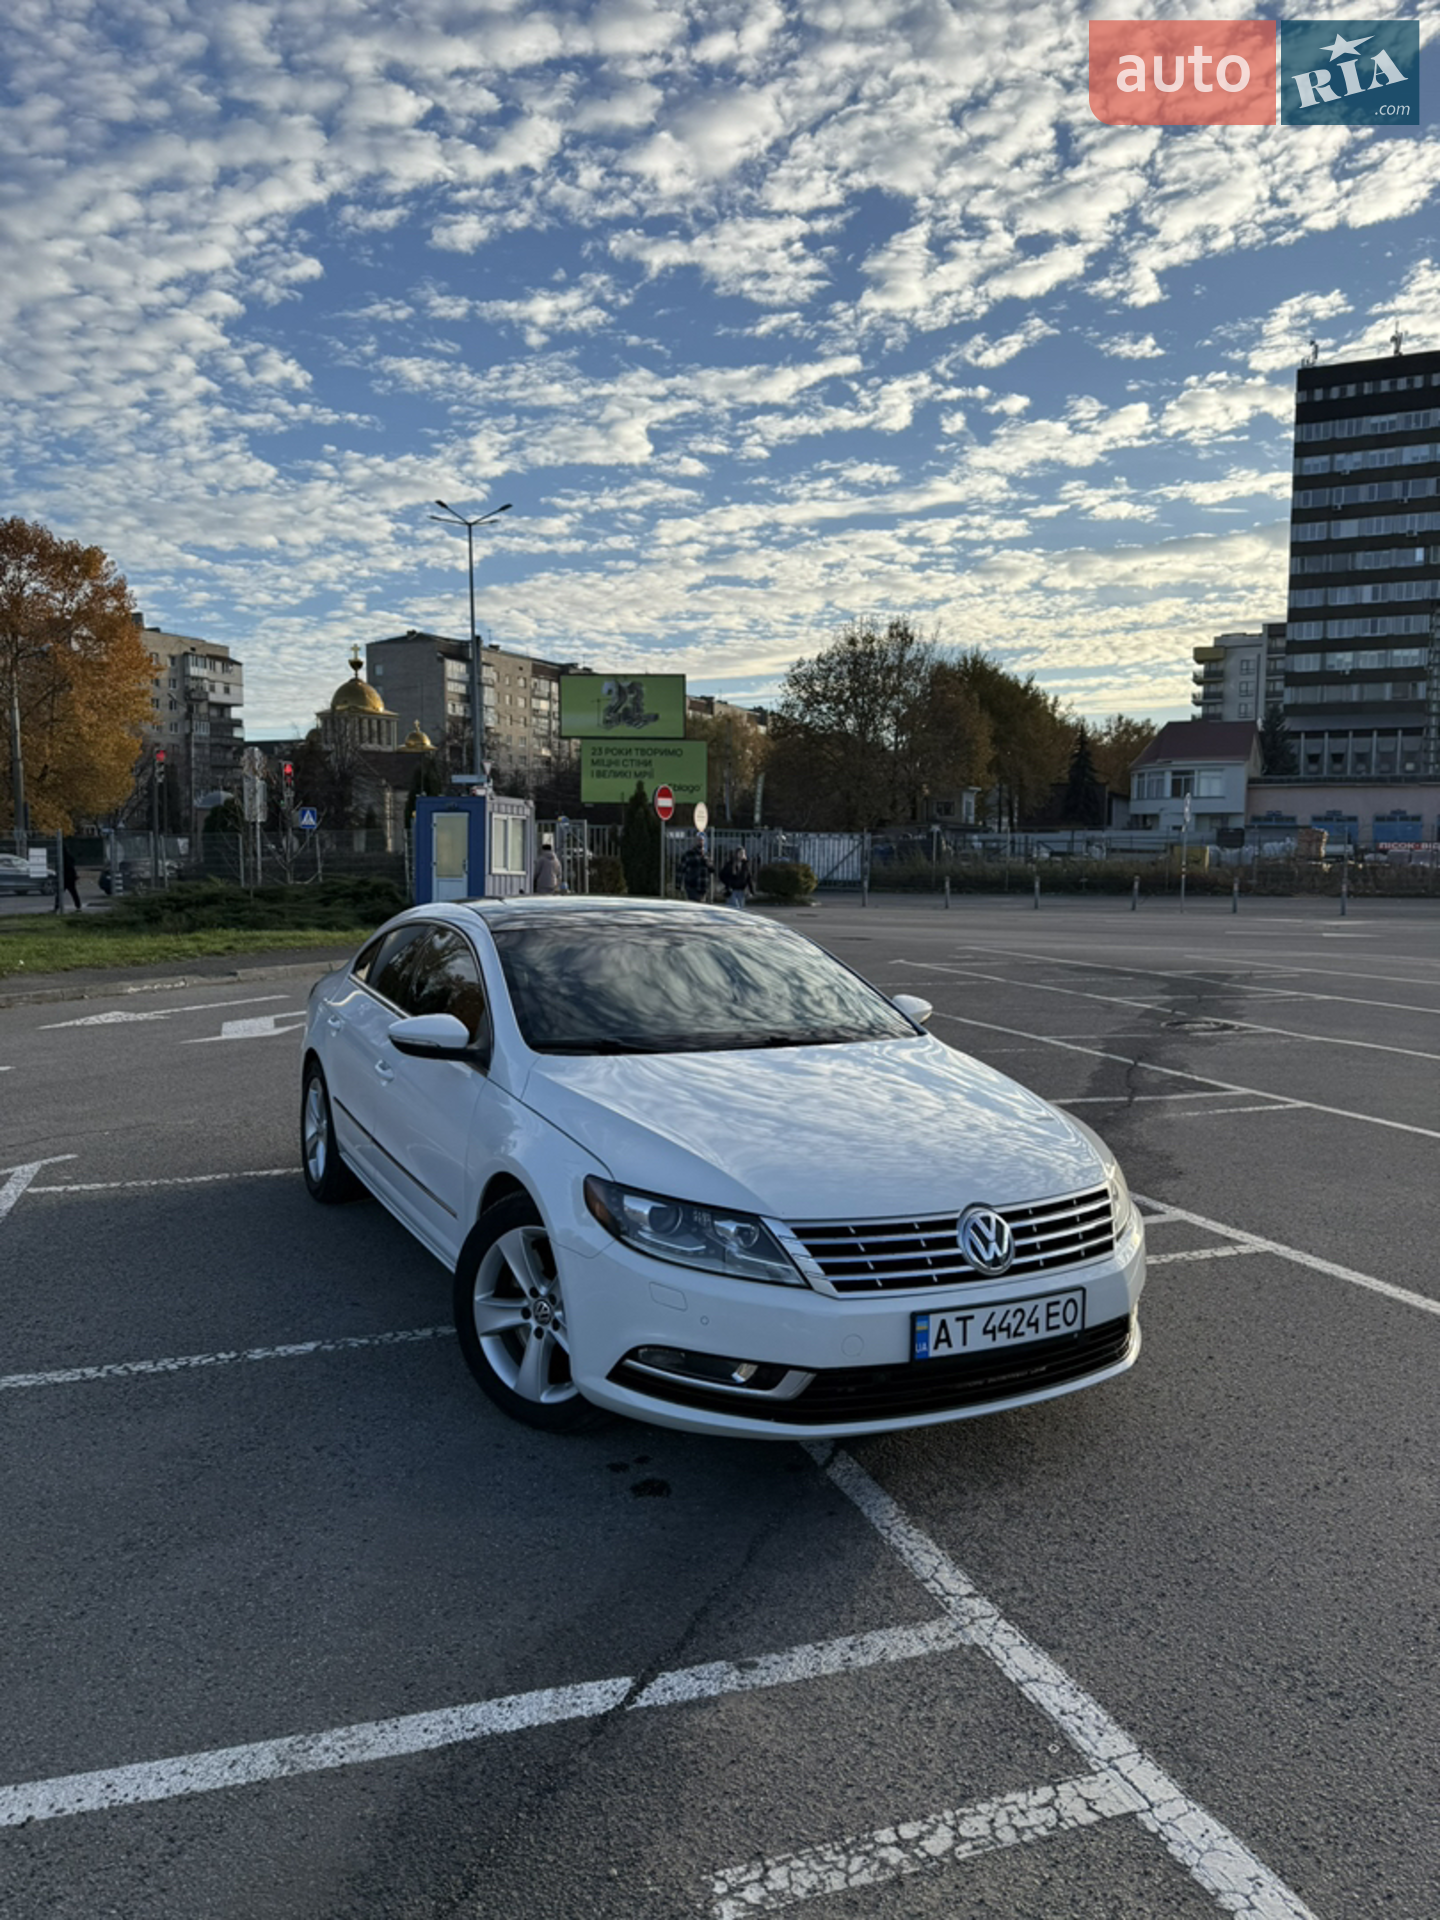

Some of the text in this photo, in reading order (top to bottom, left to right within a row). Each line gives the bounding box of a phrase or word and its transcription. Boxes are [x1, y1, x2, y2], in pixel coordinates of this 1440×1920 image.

[591, 746, 684, 758] 23 РОКИ ТВОРИМО
[591, 758, 652, 768] МІЦНІ СТІНИ
[596, 769, 632, 779] ВЕЛИКІ
[634, 768, 654, 779] МРІЇ
[933, 1315, 975, 1350] AT
[982, 1304, 1039, 1342] 4424
[1046, 1298, 1079, 1332] EO
